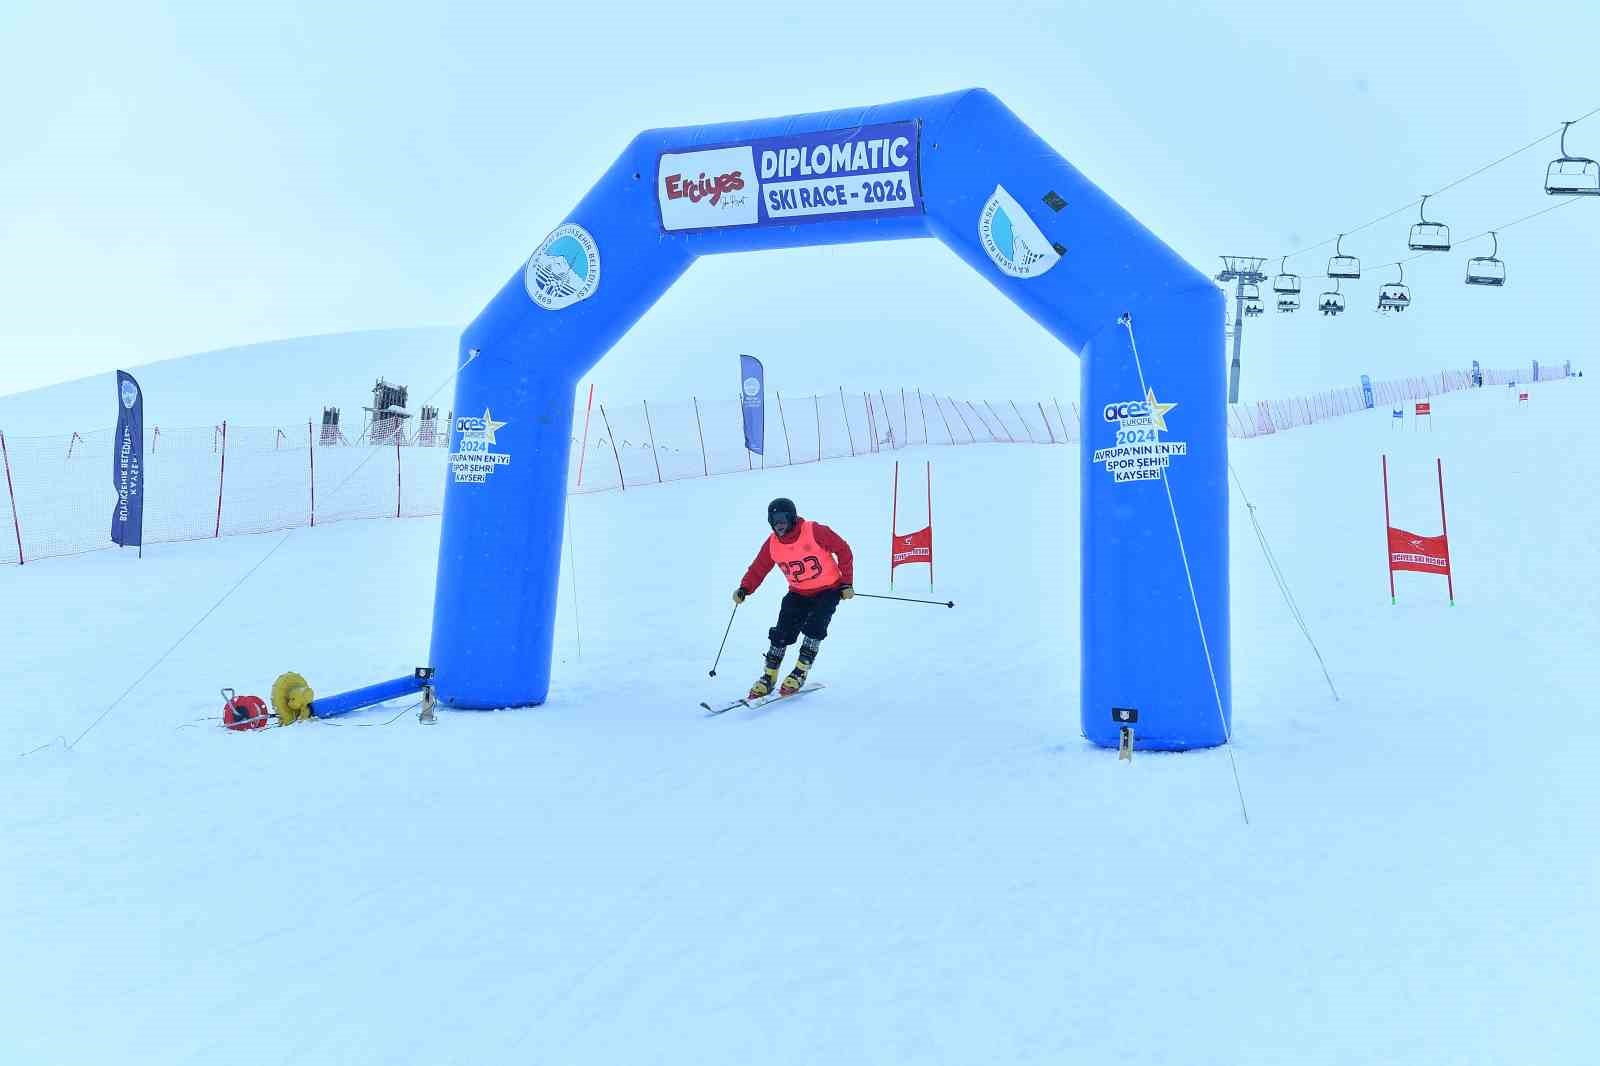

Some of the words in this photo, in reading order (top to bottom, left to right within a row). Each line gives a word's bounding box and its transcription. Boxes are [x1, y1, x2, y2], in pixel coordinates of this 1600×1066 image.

[761, 136, 909, 179] DIPLOMATIC
[665, 170, 745, 207] Erciyes
[769, 186, 797, 211] SKI
[802, 184, 848, 208] RACE
[862, 179, 907, 203] 2026
[1105, 402, 1150, 421] aces
[1118, 429, 1155, 444] 2024
[461, 441, 486, 452] 2024
[1095, 445, 1152, 460] AVRUPA'NIN
[485, 455, 496, 463] EN
[1107, 459, 1134, 470] SPOR
[1116, 469, 1159, 481] KAYSERİ
